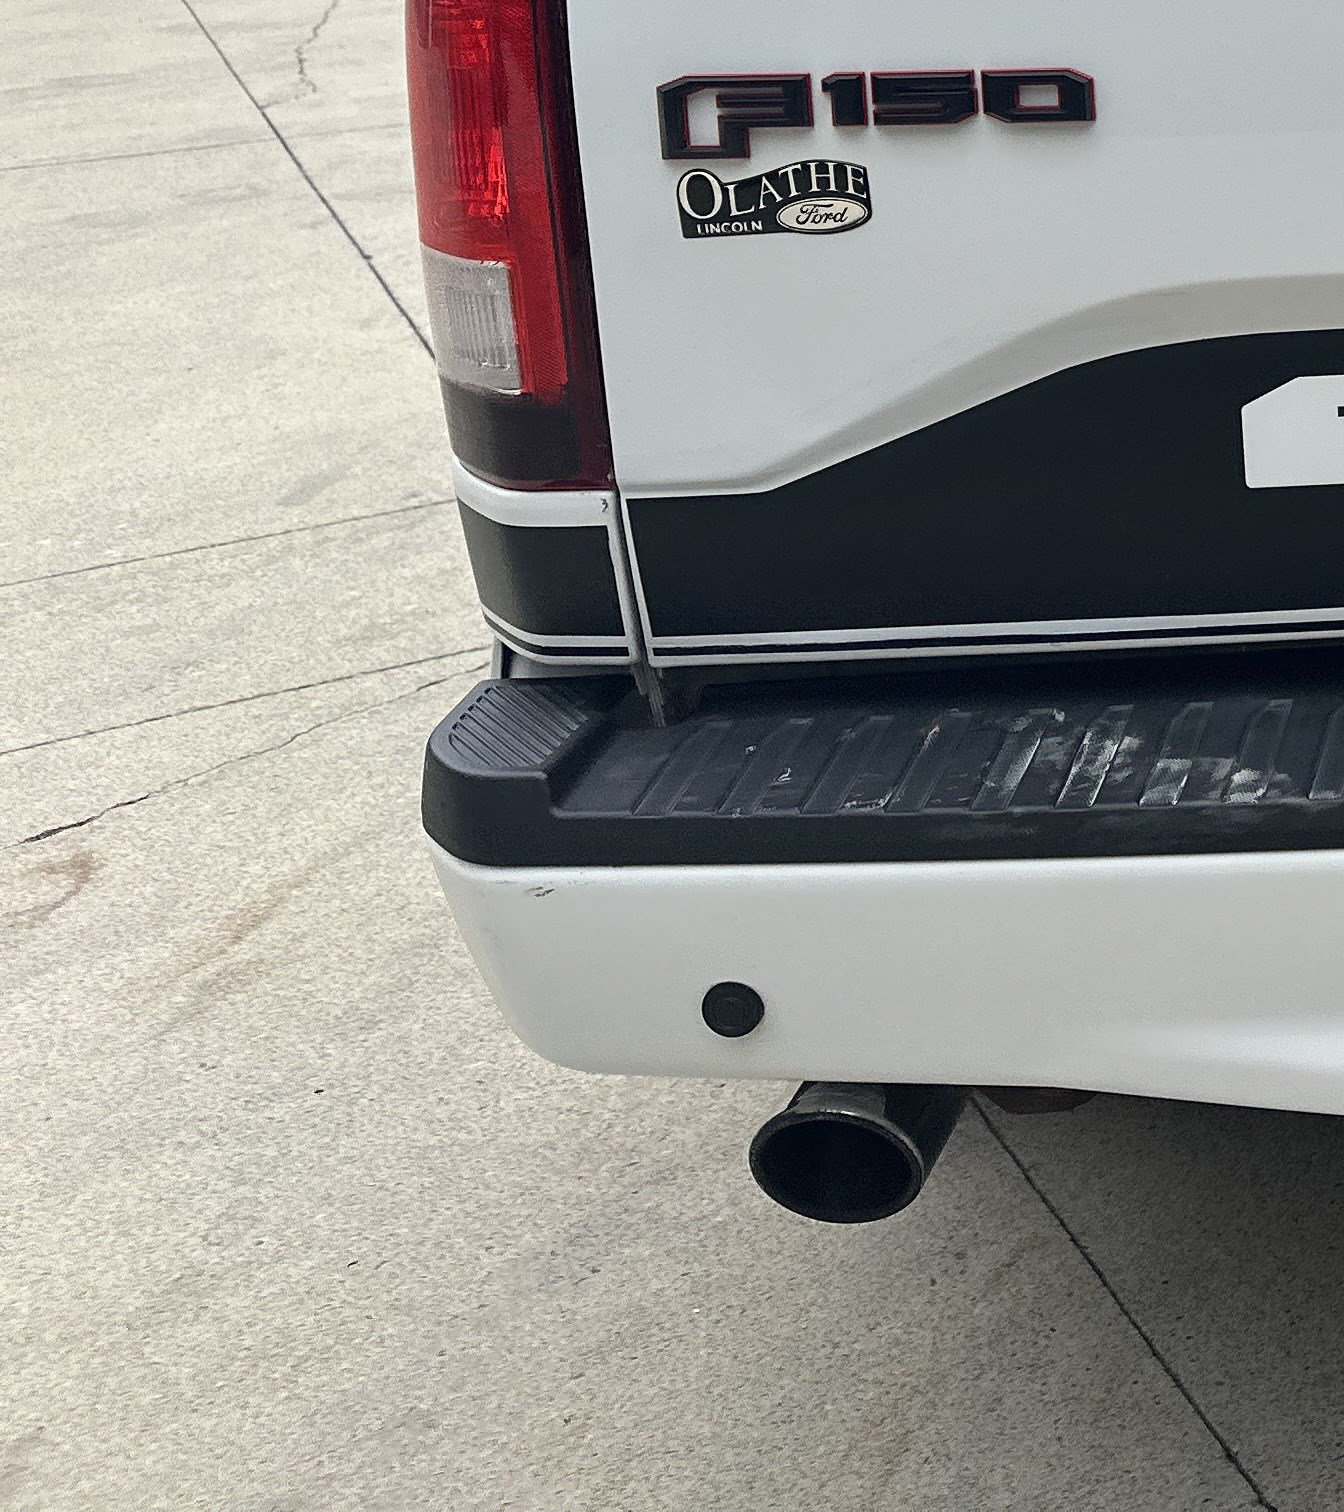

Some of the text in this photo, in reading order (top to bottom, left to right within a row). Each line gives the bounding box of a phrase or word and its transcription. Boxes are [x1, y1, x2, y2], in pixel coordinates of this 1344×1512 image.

[678, 161, 868, 220] OLATHE
[795, 203, 848, 225] Ford
[697, 220, 763, 234] LINCOLN
